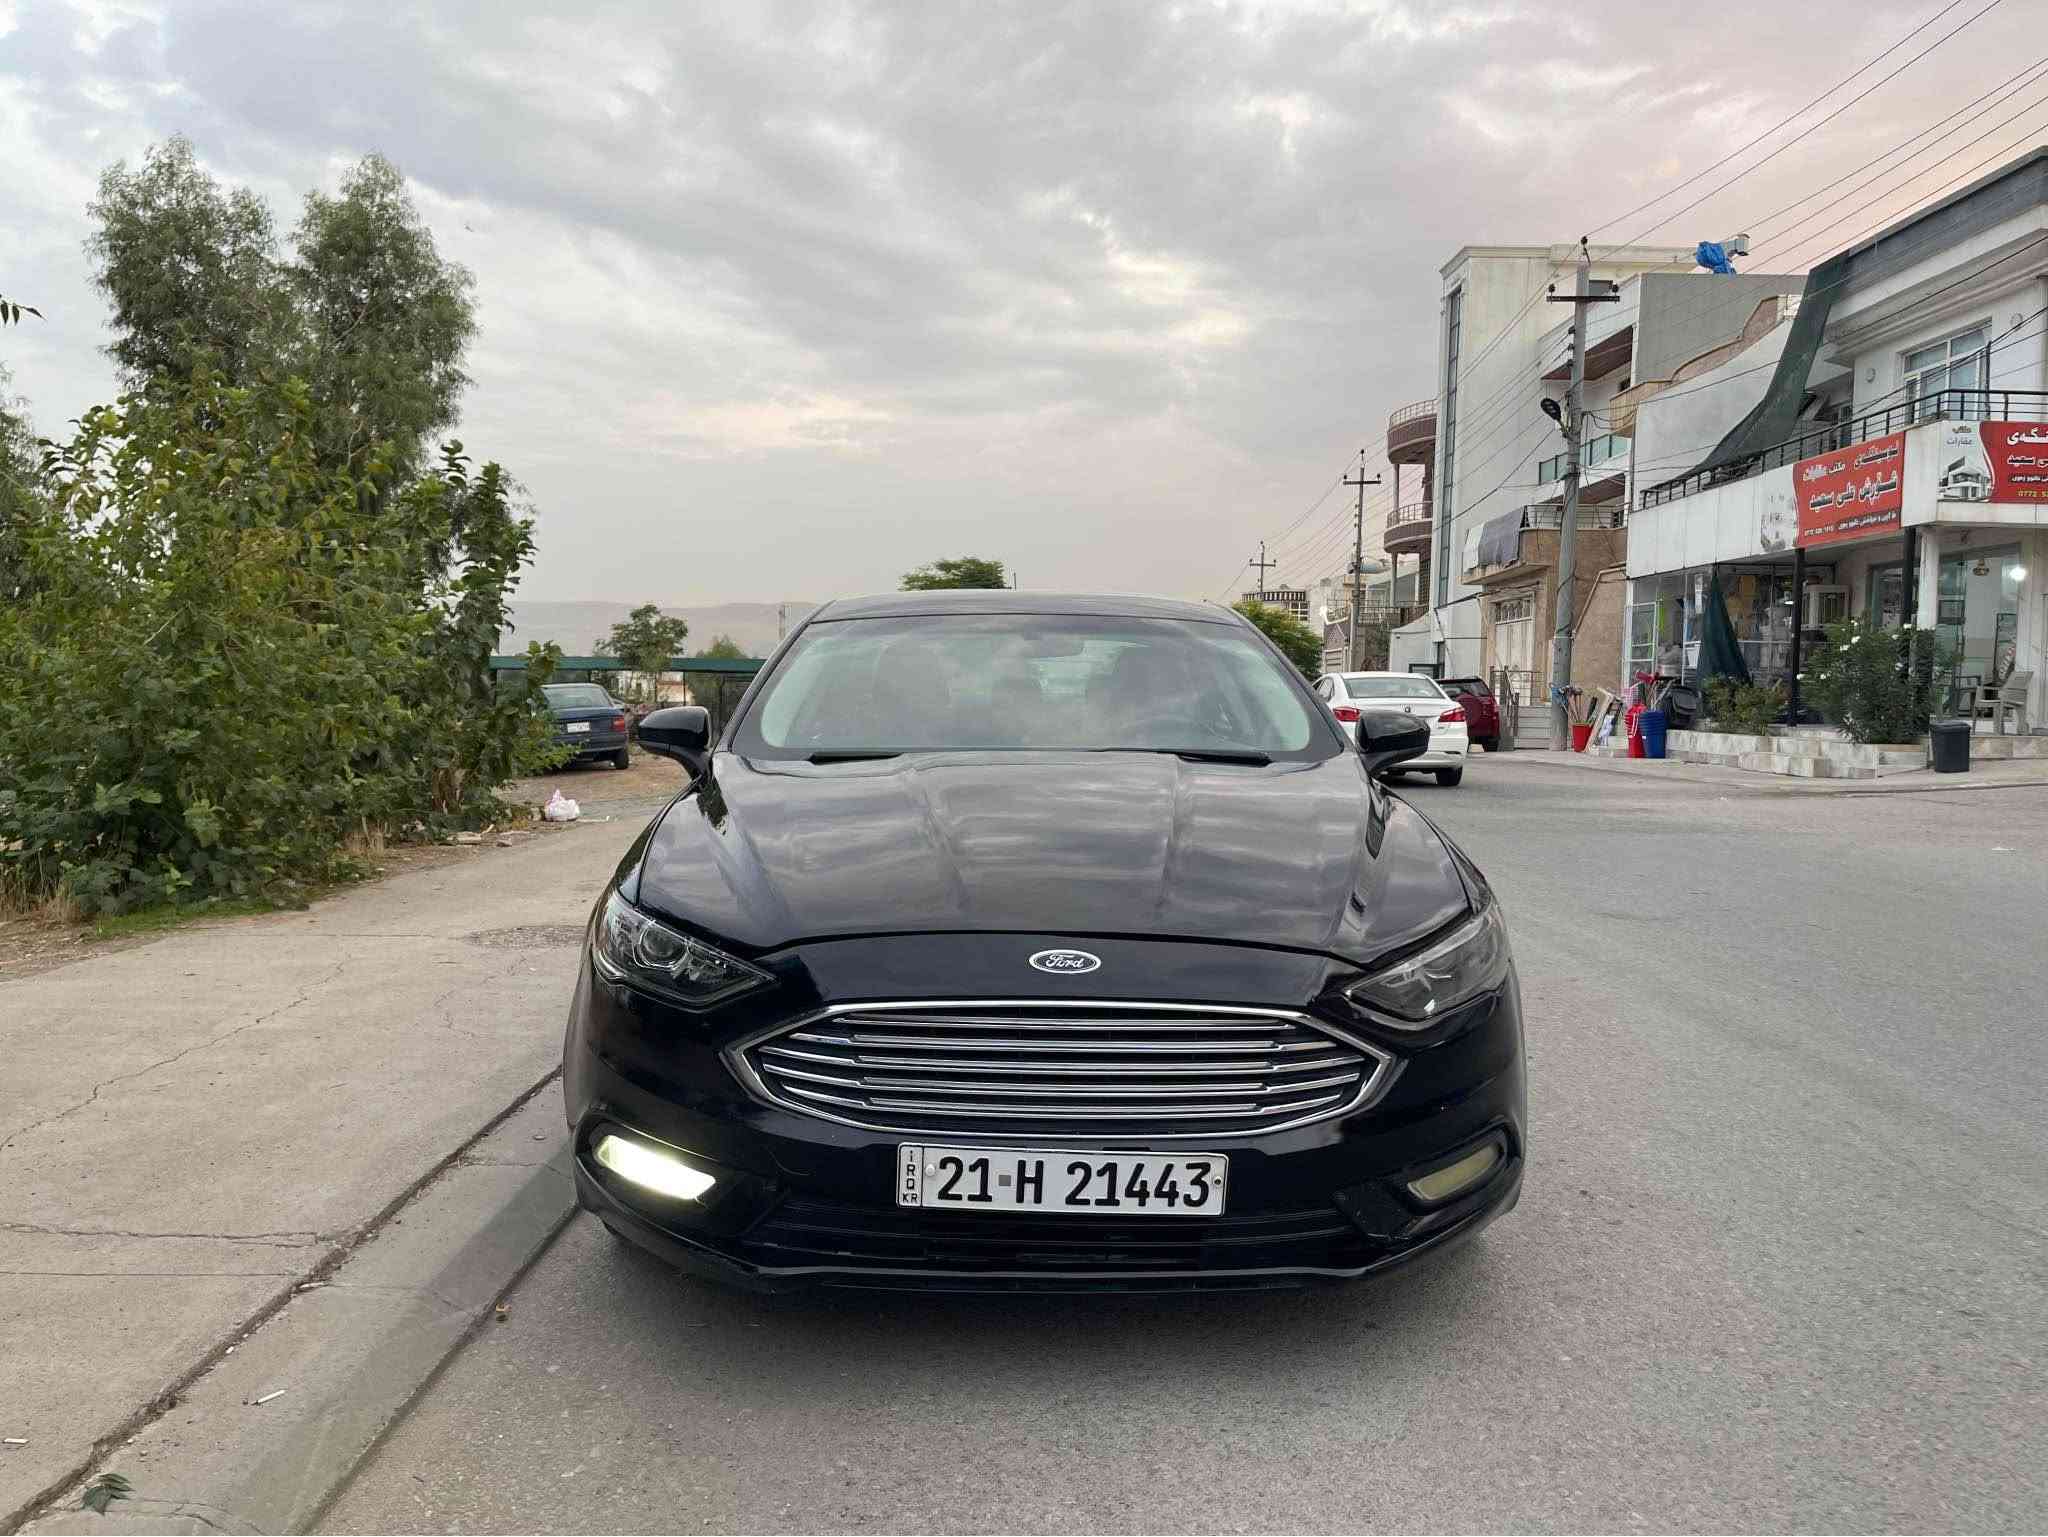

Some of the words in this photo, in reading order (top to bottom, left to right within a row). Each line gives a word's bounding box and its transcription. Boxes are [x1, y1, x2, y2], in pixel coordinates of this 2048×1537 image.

[1046, 953, 1084, 968] Ford
[937, 1156, 993, 1203] 21
[1015, 1159, 1045, 1205] H
[1064, 1160, 1212, 1208] 21443
[902, 1193, 918, 1203] KR
